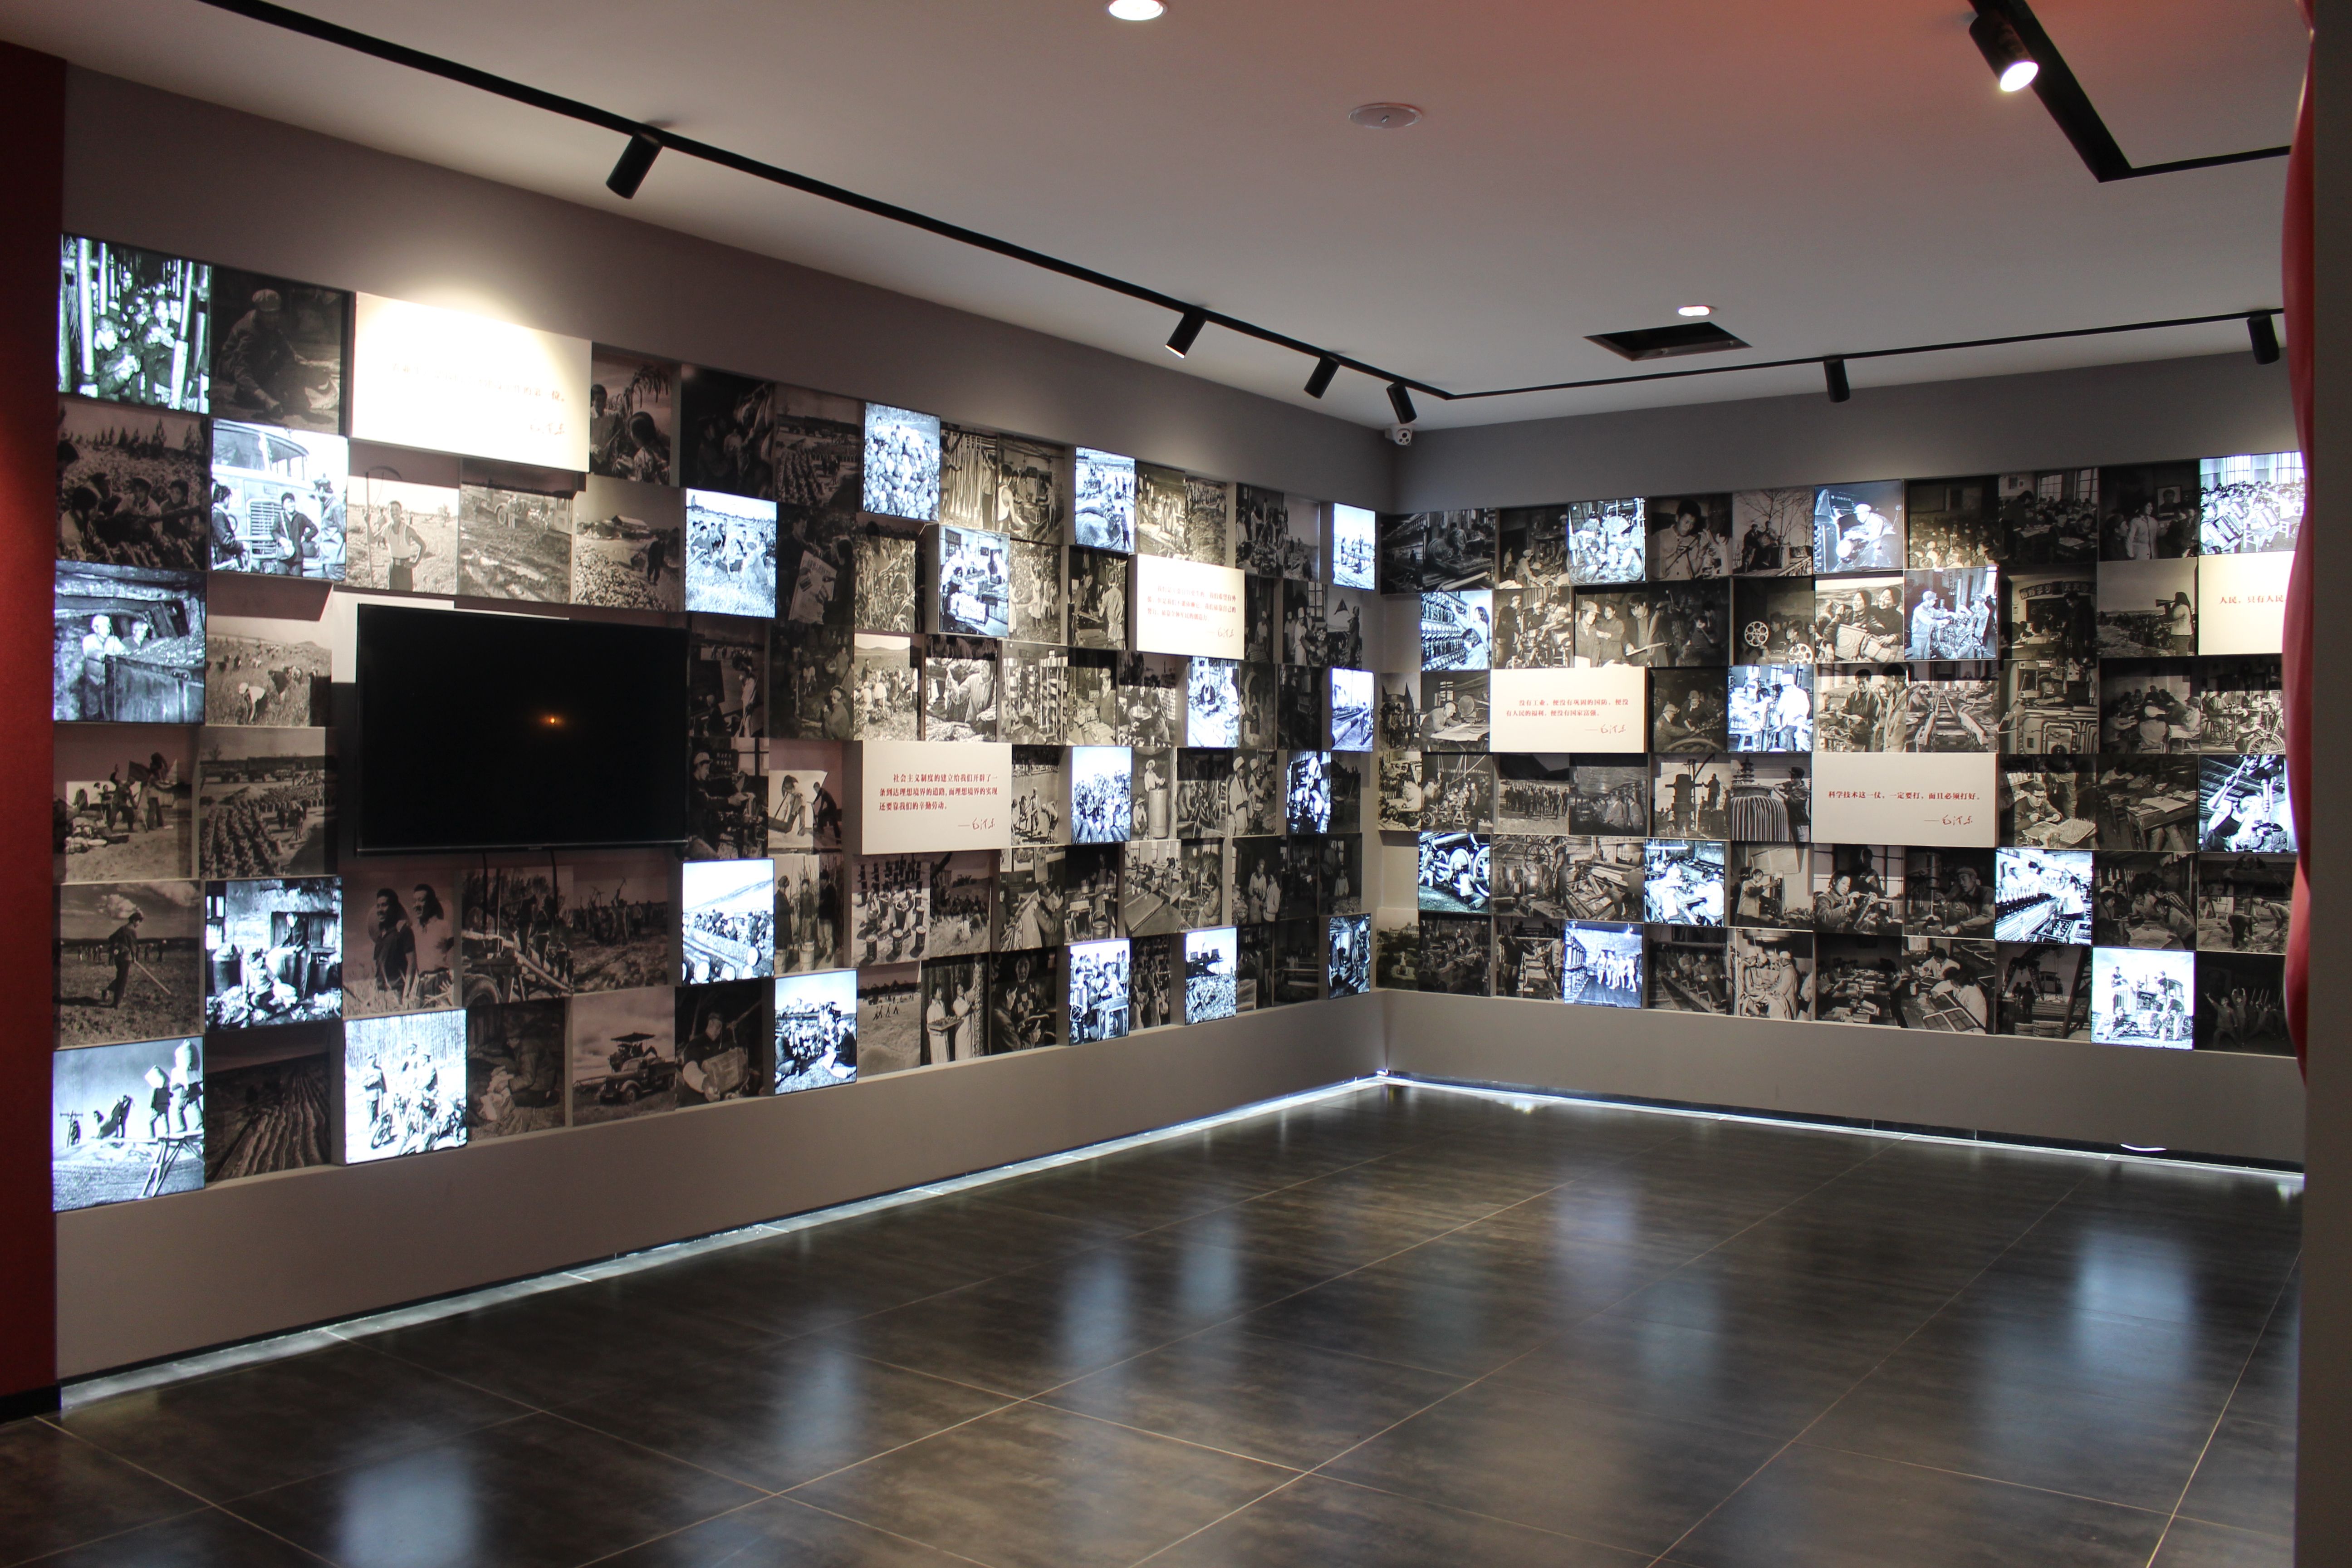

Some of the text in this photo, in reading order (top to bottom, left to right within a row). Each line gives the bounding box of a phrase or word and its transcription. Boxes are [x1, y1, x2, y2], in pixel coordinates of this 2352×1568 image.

[893, 774, 998, 783] 社会主义制度的建立给我们开辟了一
[1828, 791, 1980, 800] 科学技术这一仗，一定要打，而且必须打好。
[879, 801, 947, 811] 还要靠我们的辛勤劳动。
